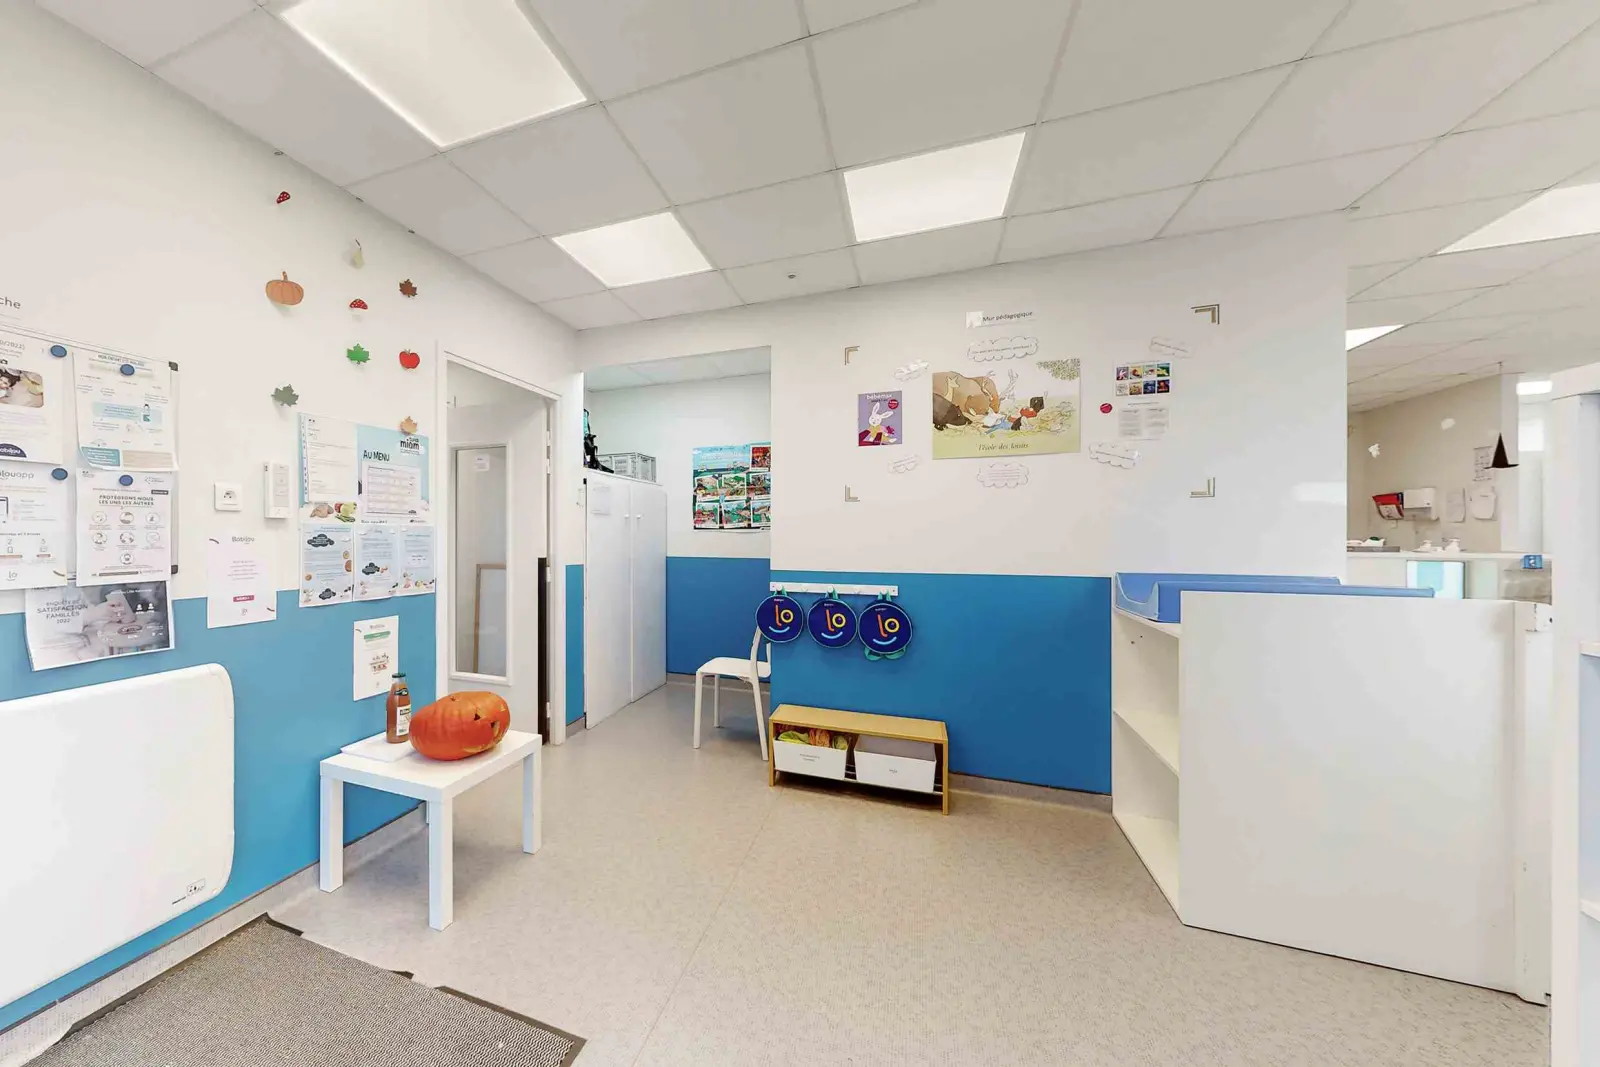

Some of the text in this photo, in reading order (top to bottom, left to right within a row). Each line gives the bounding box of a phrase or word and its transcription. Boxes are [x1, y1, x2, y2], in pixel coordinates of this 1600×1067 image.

[995, 311, 1033, 321] pédagogique
[400, 437, 420, 451] miam
[36, 603, 89, 614] SATISFACTION
